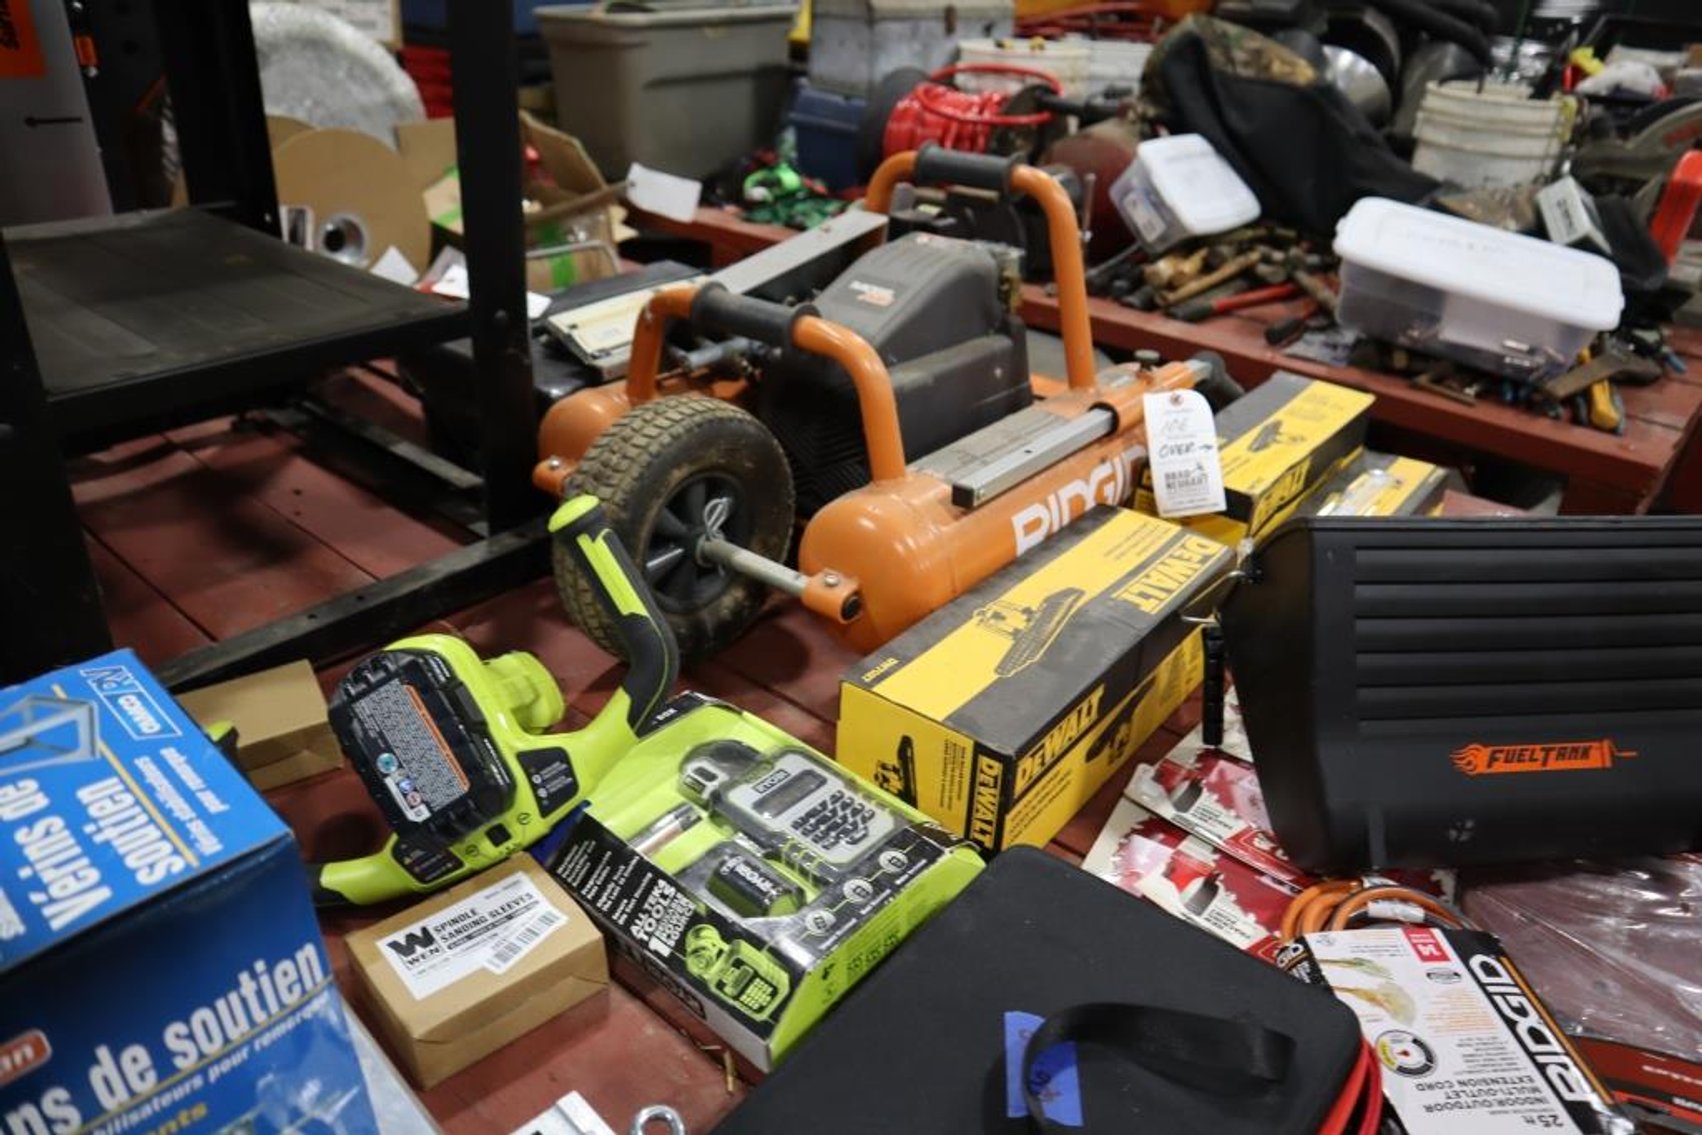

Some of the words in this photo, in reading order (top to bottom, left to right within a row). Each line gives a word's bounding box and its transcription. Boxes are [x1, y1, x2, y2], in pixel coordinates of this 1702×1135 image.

[1119, 534, 1225, 613] DEWALT
[1014, 687, 1105, 797] DEWALT
[1486, 744, 1593, 769] FUELTANK
[970, 754, 1003, 849] DEWALT
[76, 776, 187, 885] soutien
[433, 908, 479, 933] SPINDLE
[440, 914, 489, 943] SANDING
[488, 892, 534, 920] SLEEVES
[639, 885, 677, 942] TOOLS
[406, 946, 441, 967] WEN
[88, 1044, 158, 1111] de
[163, 942, 324, 1070] soutien
[1469, 953, 1592, 1102] RIDGID
[1415, 1079, 1455, 1092] CORD
[1457, 1075, 1536, 1088] EXTENSION
[1537, 1114, 1564, 1128] 25
